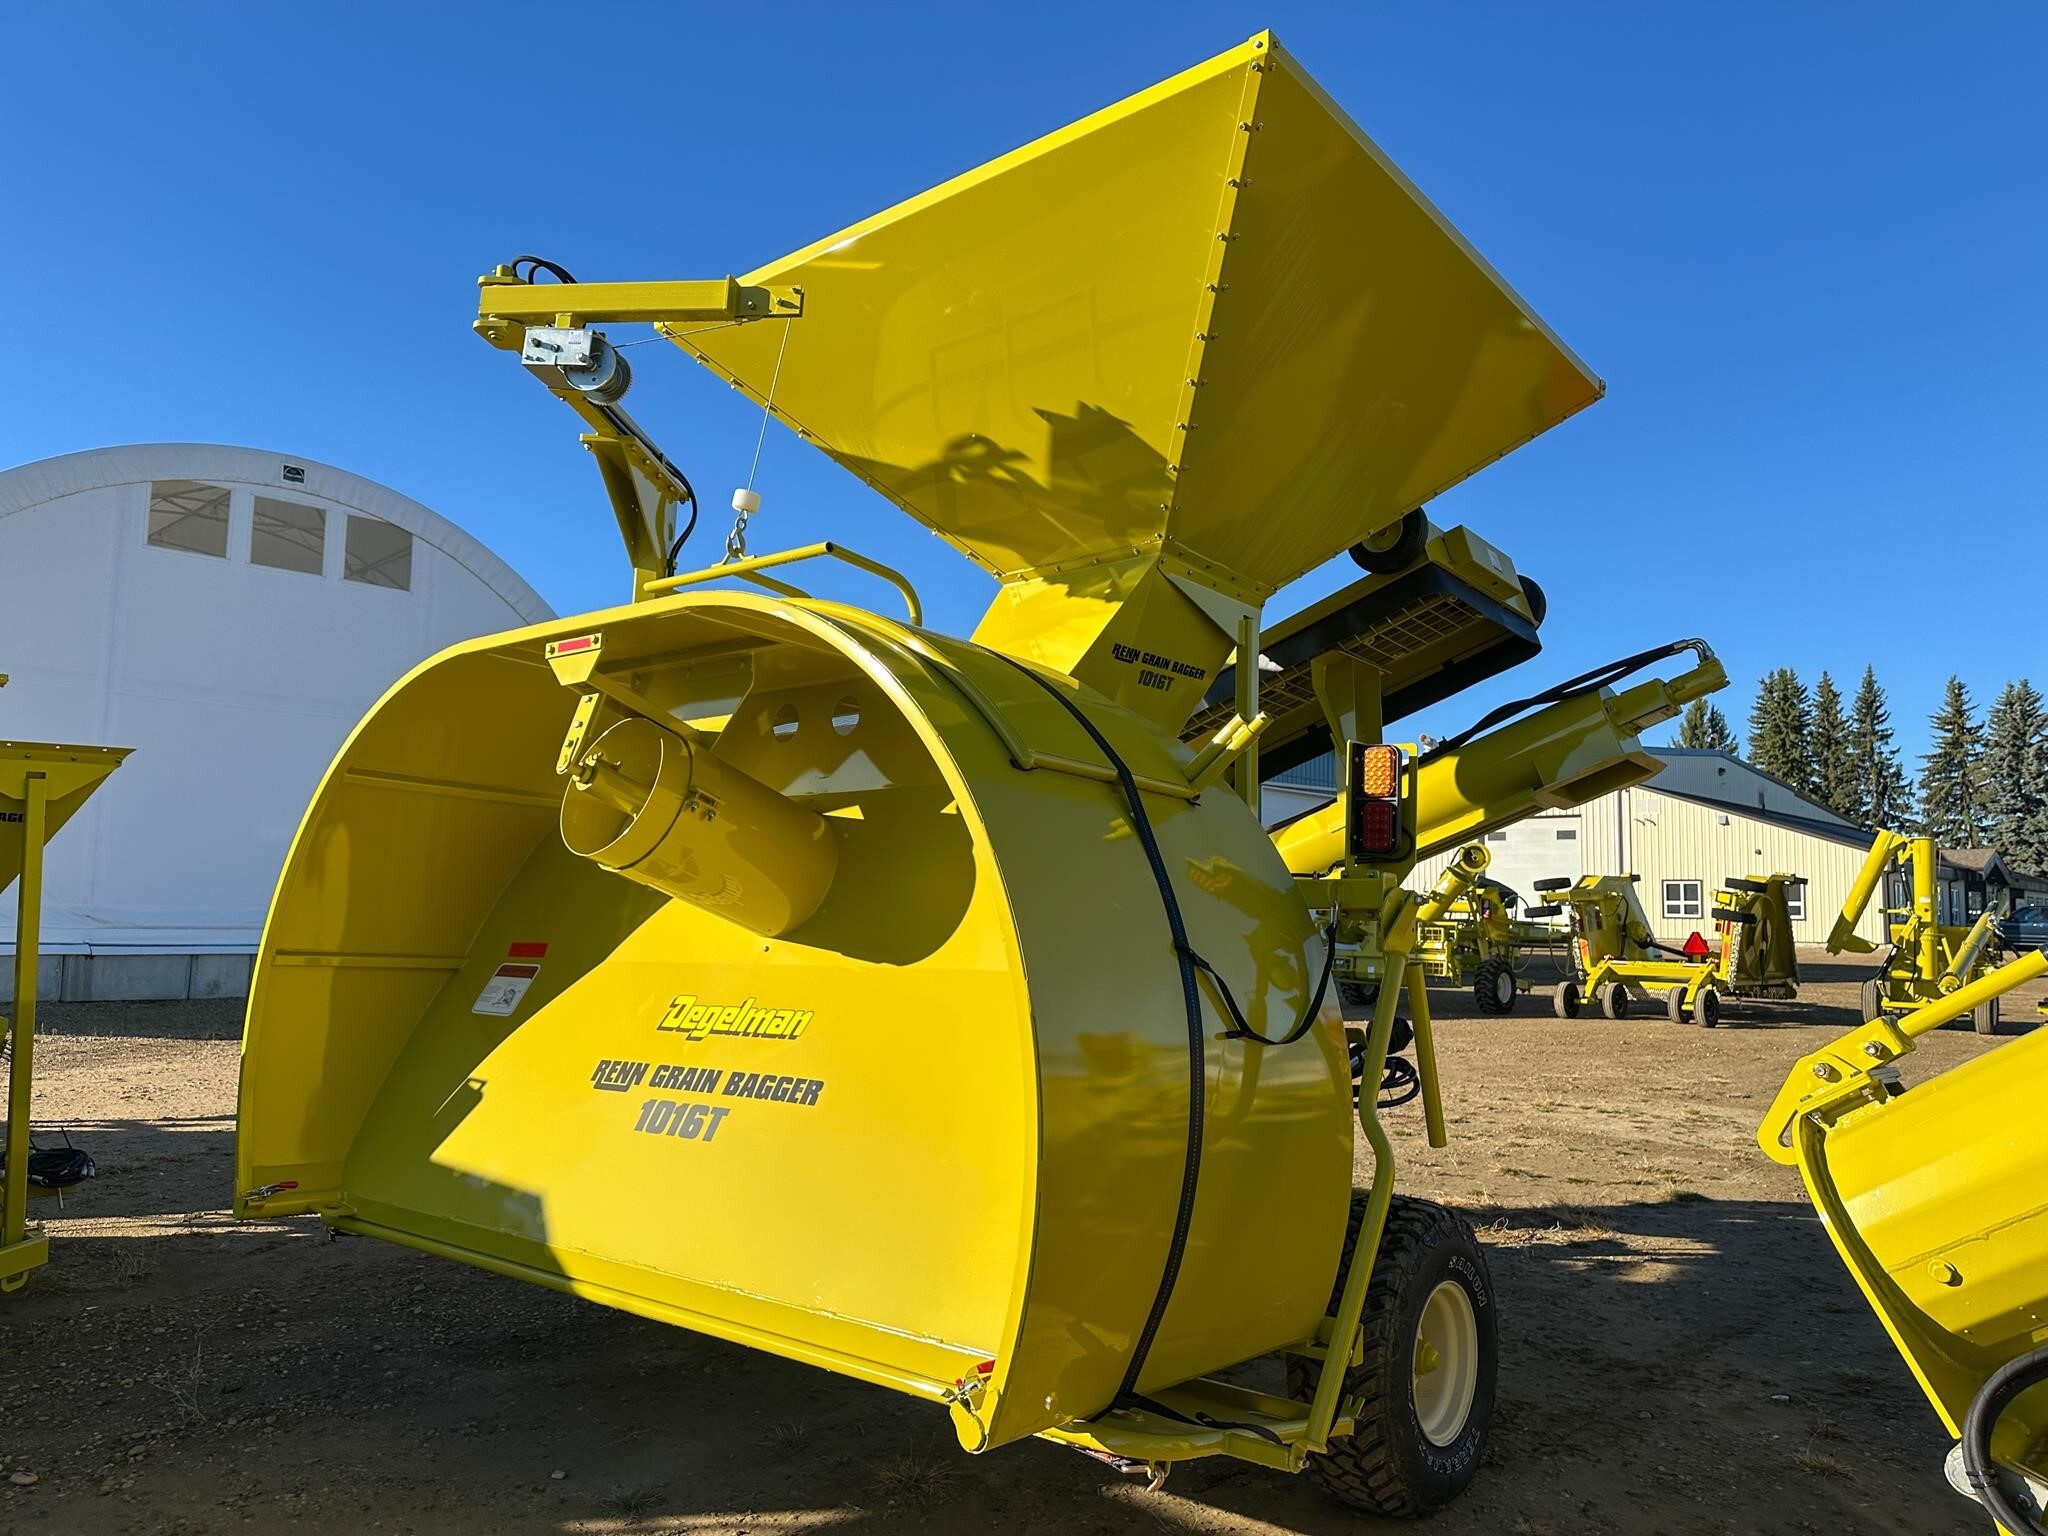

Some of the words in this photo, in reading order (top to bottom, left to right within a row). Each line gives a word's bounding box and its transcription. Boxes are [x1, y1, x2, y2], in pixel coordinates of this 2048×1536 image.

[1112, 643, 1141, 664] RENN
[1142, 652, 1171, 671] GRAIN
[1171, 662, 1206, 681] BAGGER
[1138, 669, 1175, 692] 1016T
[656, 994, 814, 1041] Degelman
[591, 1060, 649, 1092] RENN
[649, 1064, 722, 1094] GRAIN
[722, 1071, 825, 1106] BAGGER
[634, 1098, 731, 1142] 1016T
[1448, 1256, 1488, 1307] SAILUN
